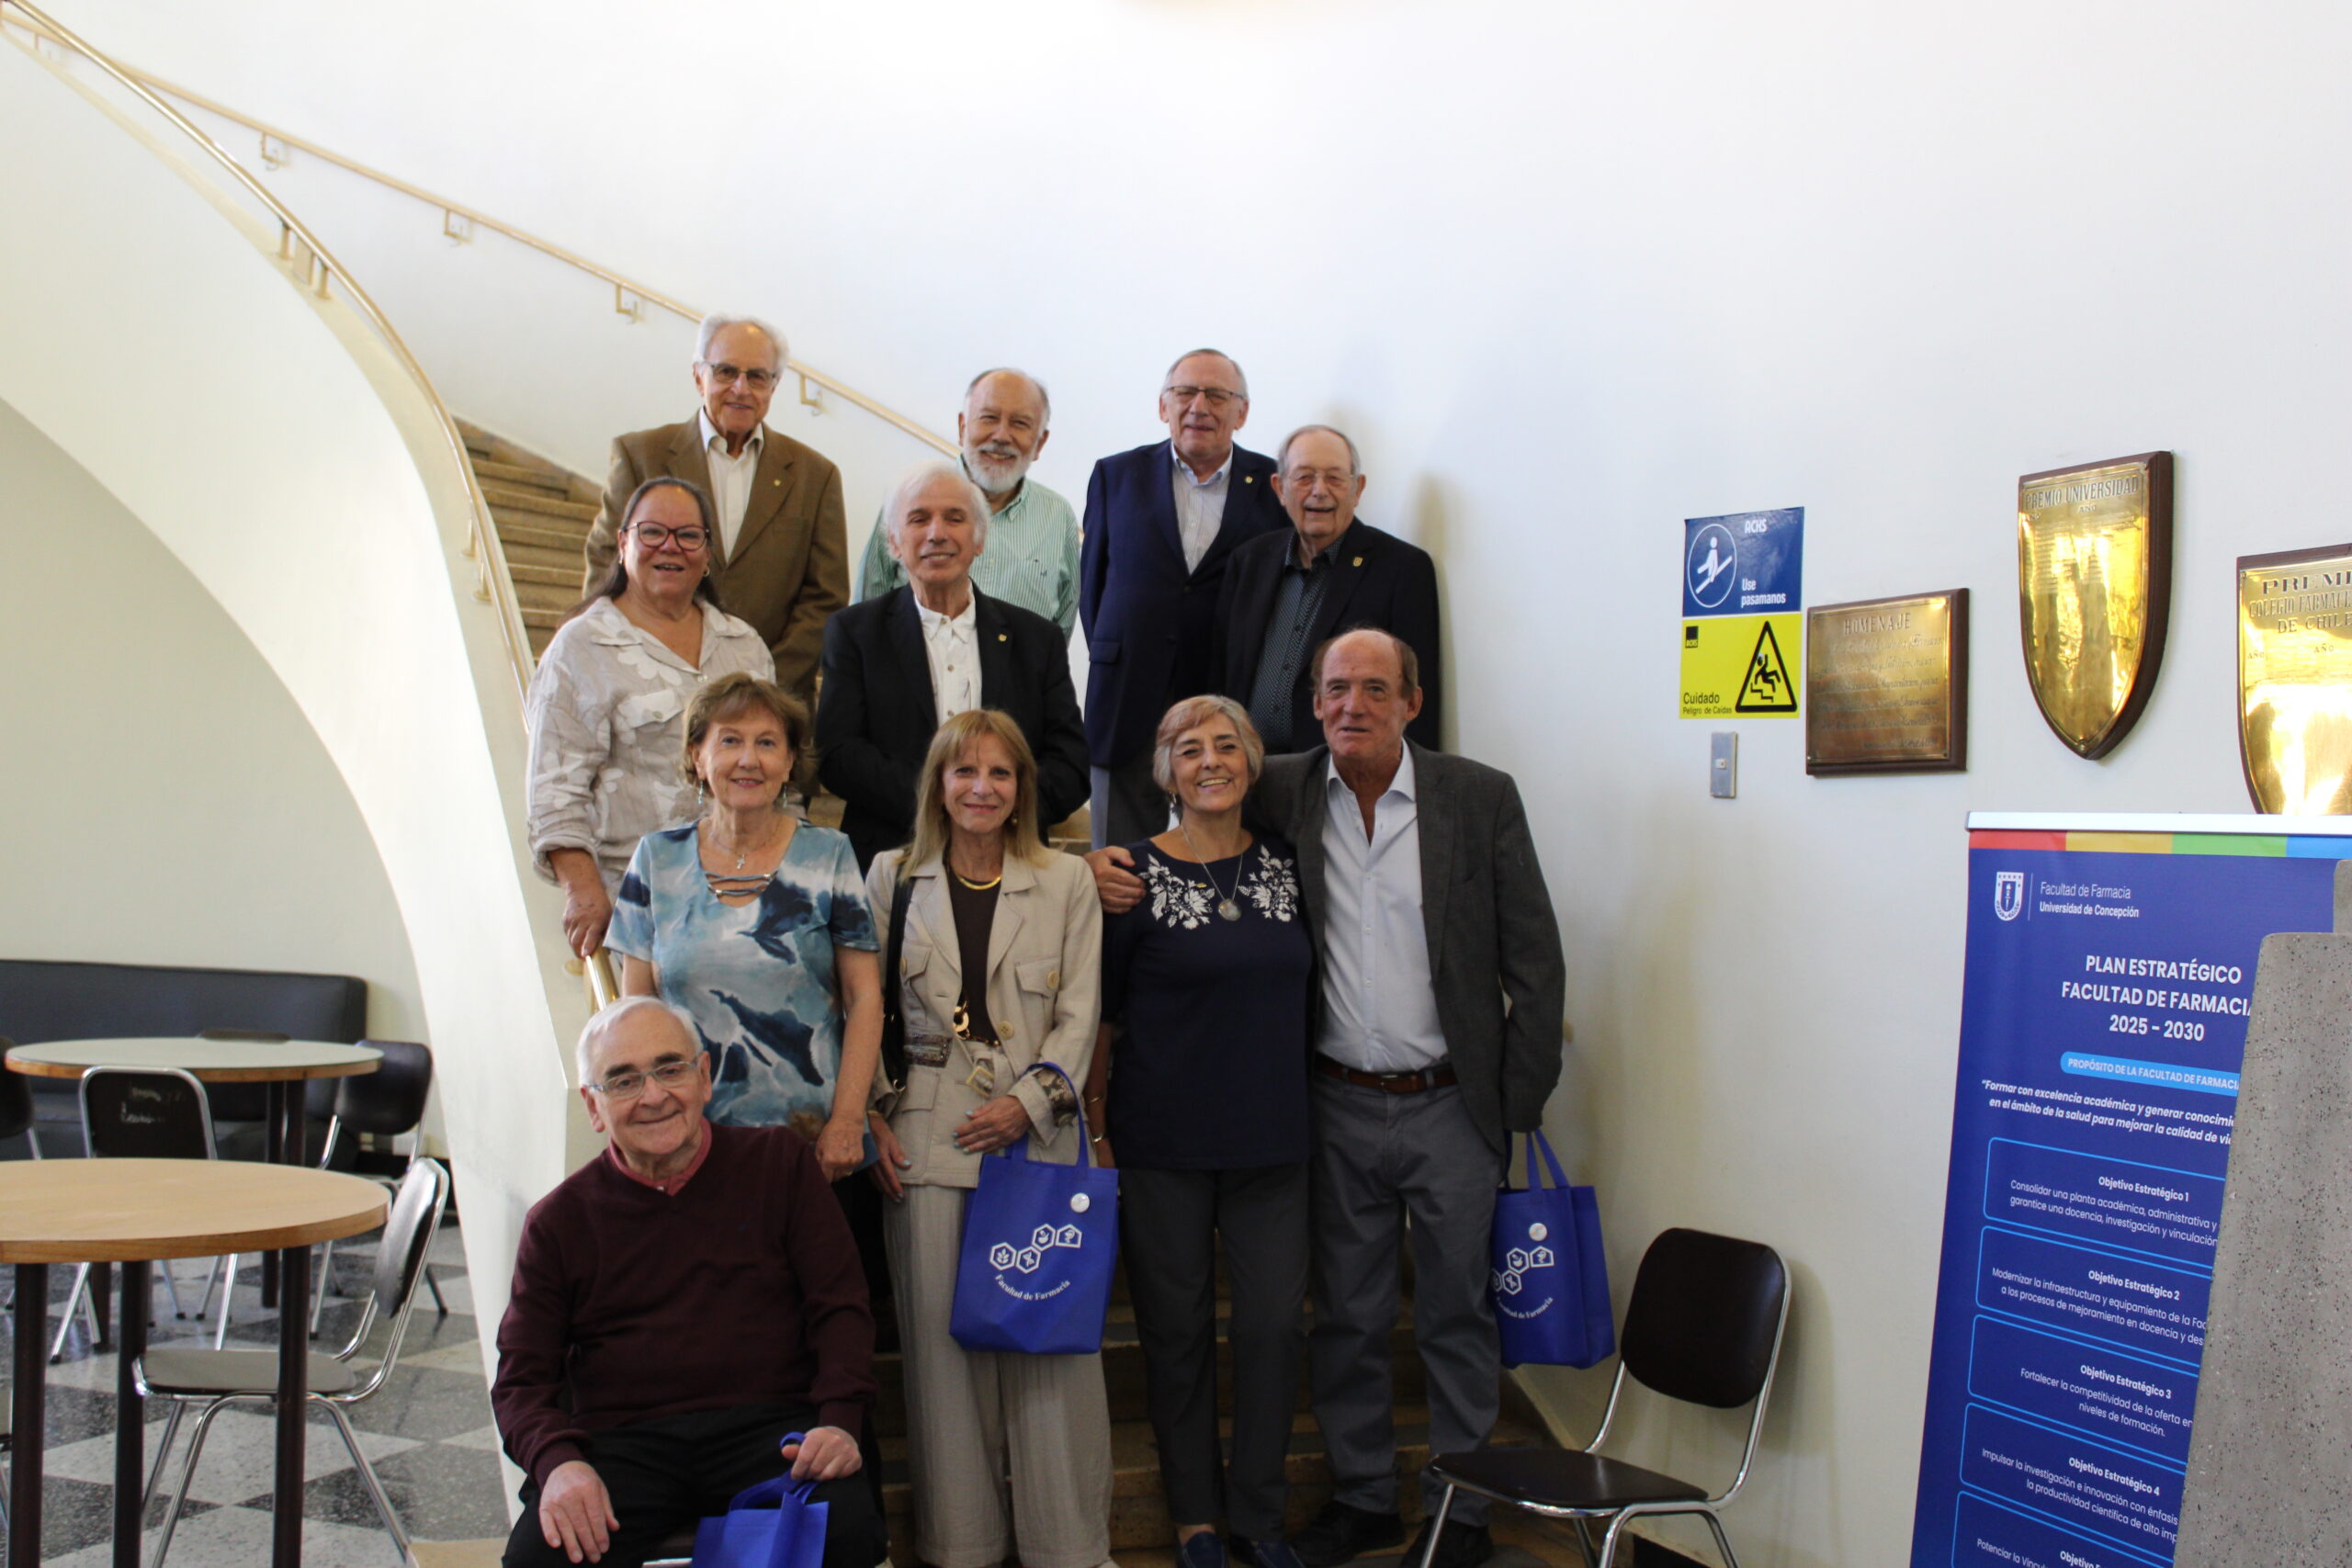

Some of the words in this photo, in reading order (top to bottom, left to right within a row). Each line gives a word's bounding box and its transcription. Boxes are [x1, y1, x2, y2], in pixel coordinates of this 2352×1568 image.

[2025, 489, 2062, 511] PREMIO
[2065, 477, 2139, 503] UNIVERSIDAD
[1742, 579, 1757, 591] Use
[1741, 592, 1787, 608] pasamanos
[2250, 597, 2295, 617] COLEGIO
[1844, 612, 1912, 635] HOMENAJE
[2278, 617, 2298, 634] DE
[2247, 649, 2265, 660] AÑO
[2314, 643, 2335, 653] AÑO
[1683, 692, 1720, 705] Cuidado
[1683, 706, 1702, 716] Peligro
[2041, 882, 2075, 896] Facultad
[2078, 885, 2088, 897] de
[2091, 885, 2131, 898] Farmacia
[2040, 901, 2082, 914] Universidad
[2084, 904, 2092, 915] de
[2095, 904, 2139, 919] Concepción
[2086, 954, 2125, 975] PLAN
[2129, 958, 2241, 984] ESTRATÉGICO
[2062, 981, 2143, 1004] FACULTAD
[2146, 989, 2165, 1008] DE
[2109, 1014, 2147, 1034] 2025
[2164, 1021, 2204, 1042] 2030
[2068, 1058, 2113, 1073] PROPÓSITO
[2116, 1061, 2125, 1074] DE
[2127, 1063, 2136, 1076] LA
[2139, 1065, 2182, 1082] FACULTAD
[2184, 1072, 2194, 1084] DE
[2018, 1087, 2033, 1096] con
[2035, 1089, 2082, 1103] excelencia
[2084, 1097, 2136, 1112] académica
[2138, 1105, 2144, 1116] y
[2145, 1106, 2184, 1119] generar
[1989, 1099, 2001, 1108] en
[2002, 1100, 2010, 1109] el
[2011, 1100, 2041, 1113] ámbito
[2043, 1106, 2053, 1116] de
[2056, 1107, 2064, 1117] la
[2065, 1111, 2091, 1122] salud
[2091, 1114, 2114, 1126] para
[2116, 1119, 2154, 1132] mejorar
[2154, 1122, 2165, 1134] la
[2166, 1127, 2203, 1140] calidad
[2205, 1132, 2217, 1143] de
[2098, 1176, 2133, 1191] Objetivo
[2135, 1183, 2183, 1201] Estratégico
[2186, 1192, 2188, 1201] 1
[2010, 1196, 2047, 1211] garantice
[2049, 1203, 2063, 1213] una
[2065, 1207, 2103, 1224] docencia,
[2106, 1213, 2160, 1235] investigación
[2163, 1228, 2166, 1238] y
[2011, 1179, 2052, 1196] Consolidar
[2053, 1190, 2068, 1200] una
[2070, 1192, 2096, 1205] planta
[2098, 1198, 2146, 1216] académica,
[2148, 1208, 2210, 1228] administrativa
[2211, 1222, 2217, 1233] y
[995, 1274, 1023, 1298] Facultad
[1035, 1280, 1070, 1300] Farmacia
[1993, 1268, 2032, 1284] Modernizar
[2034, 1278, 2041, 1288] la
[2042, 1280, 2100, 1303] infraestructura
[2103, 1296, 2108, 1306] y
[2109, 1298, 2166, 1319] equipamiento
[2168, 1312, 2179, 1323] de
[2182, 1314, 2189, 1325] la
[2088, 1270, 2123, 1286] Objetivo
[2124, 1279, 2173, 1298] Estratégico
[2174, 1291, 2179, 1300] 2
[2008, 1286, 2018, 1298] los
[2019, 1292, 2054, 1306] procesos
[2057, 1299, 2066, 1309] de
[2068, 1303, 2125, 1325] mejoramiento
[2127, 1318, 2137, 1328] en
[2139, 1321, 2178, 1339] docencia
[2180, 1333, 2186, 1343] y
[2080, 1365, 2115, 1383] Objetivo
[2117, 1375, 2165, 1397] Estratégico
[2165, 1389, 2172, 1399] 3
[2021, 1368, 2059, 1388] Fortalecer
[2061, 1380, 2068, 1391] la
[2070, 1383, 2131, 1409] competitividad
[2132, 1402, 2143, 1414] de
[2145, 1404, 2153, 1416] la
[2154, 1409, 2180, 1425] oferta
[2079, 1403, 2107, 1418] niveles
[2109, 1411, 2119, 1422] de
[2120, 1414, 2165, 1438] formación.
[1982, 1448, 2014, 1467] Impulsar
[2016, 1460, 2022, 1470] la
[2024, 1462, 2075, 1488] investigación
[2084, 1483, 2129, 1506] innovación
[2130, 1501, 2146, 1514] con
[2148, 1506, 2178, 1526] énfasis
[2069, 1458, 2103, 1477] Objetivo
[2104, 1469, 2152, 1493] Estratégico
[2154, 1486, 2160, 1495] 4
[2027, 1479, 2033, 1489] la
[2035, 1483, 2090, 1510] productividad
[2092, 1504, 2129, 1524] científica
[2131, 1517, 2142, 1529] de
[2143, 1522, 2160, 1536] alto
[1977, 1539, 2011, 1560] Potenciar
[2013, 1552, 2020, 1562] la
